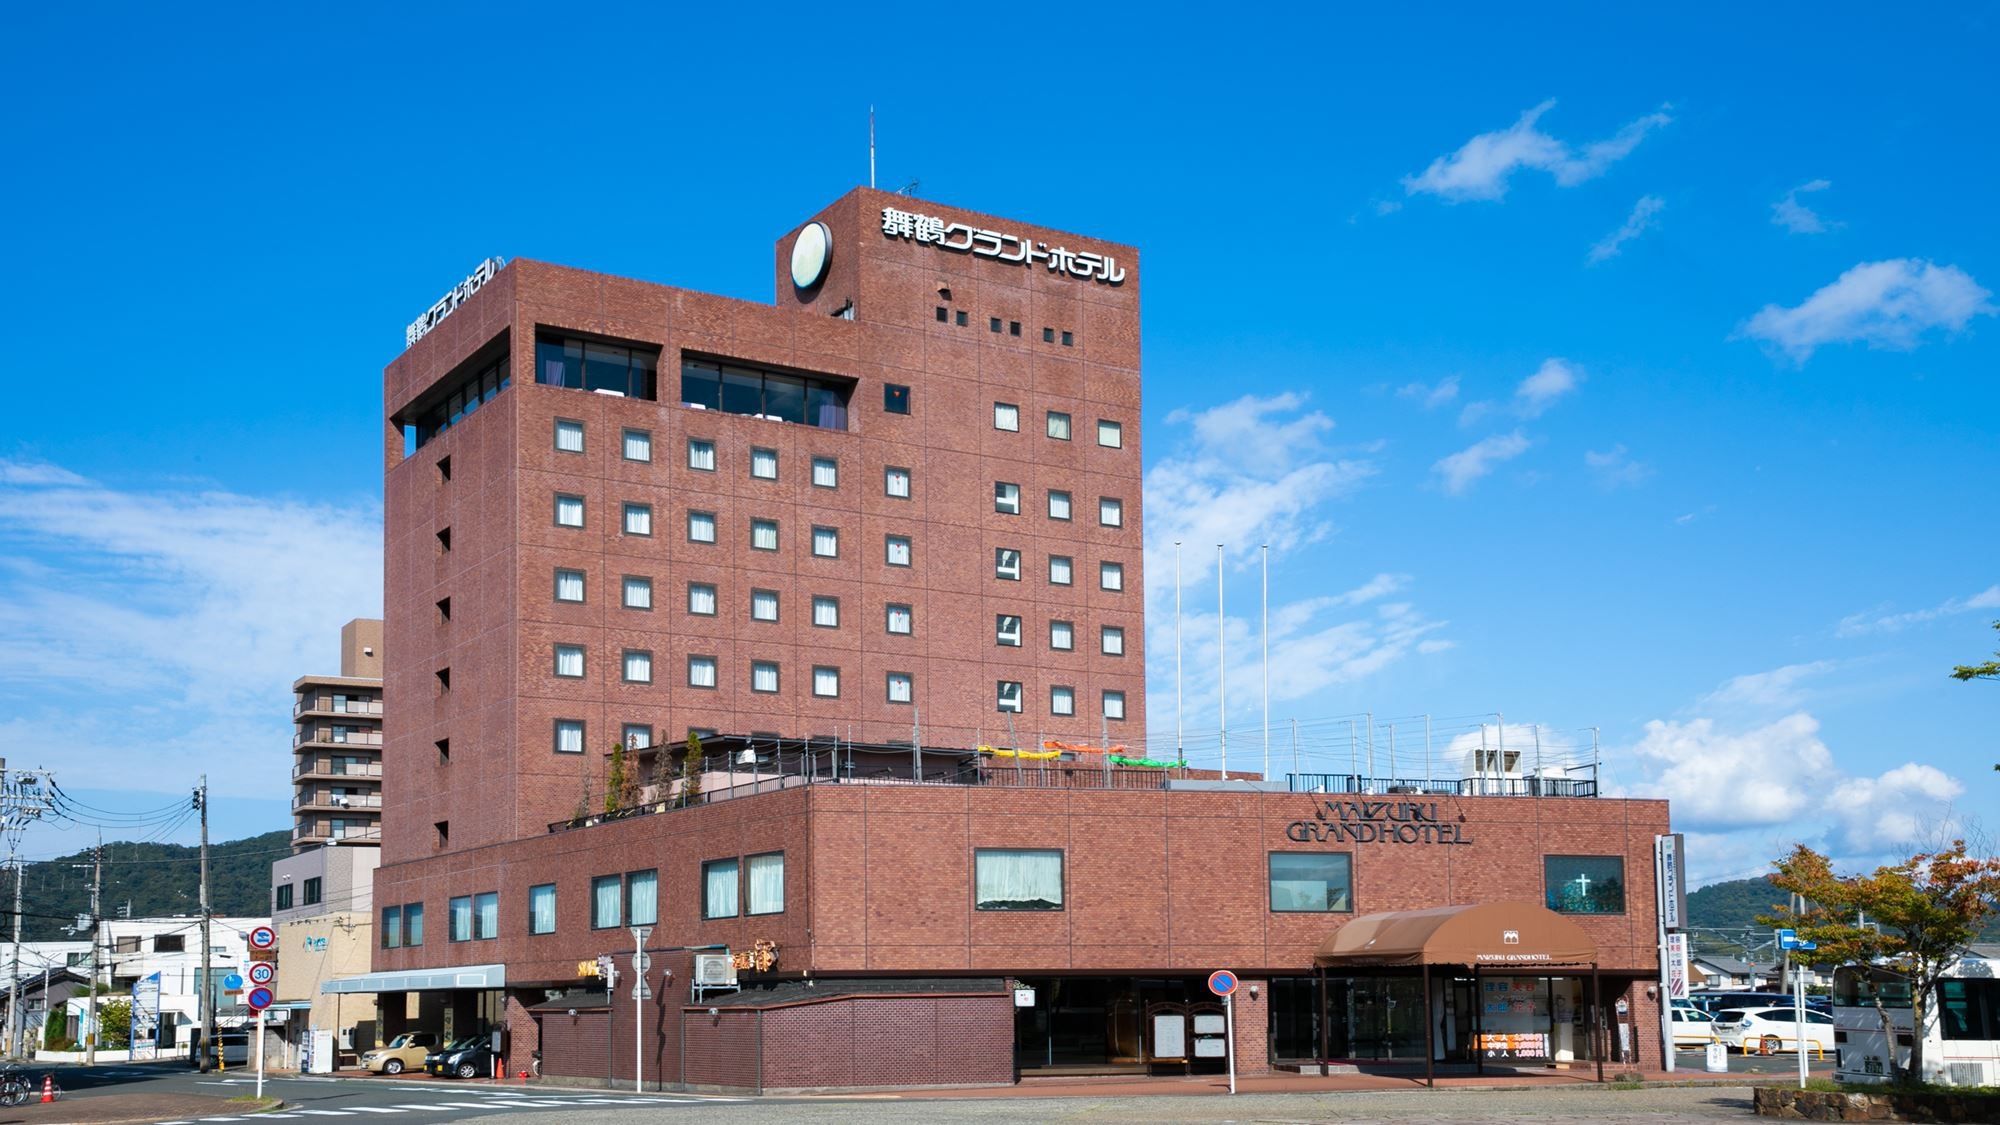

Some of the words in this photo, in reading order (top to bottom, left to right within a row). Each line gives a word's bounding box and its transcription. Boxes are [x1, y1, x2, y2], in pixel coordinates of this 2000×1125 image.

[882, 207, 1126, 283] 舞鶴グランドホテル
[1321, 801, 1437, 823] MAIZURU
[254, 969, 269, 980] 30
